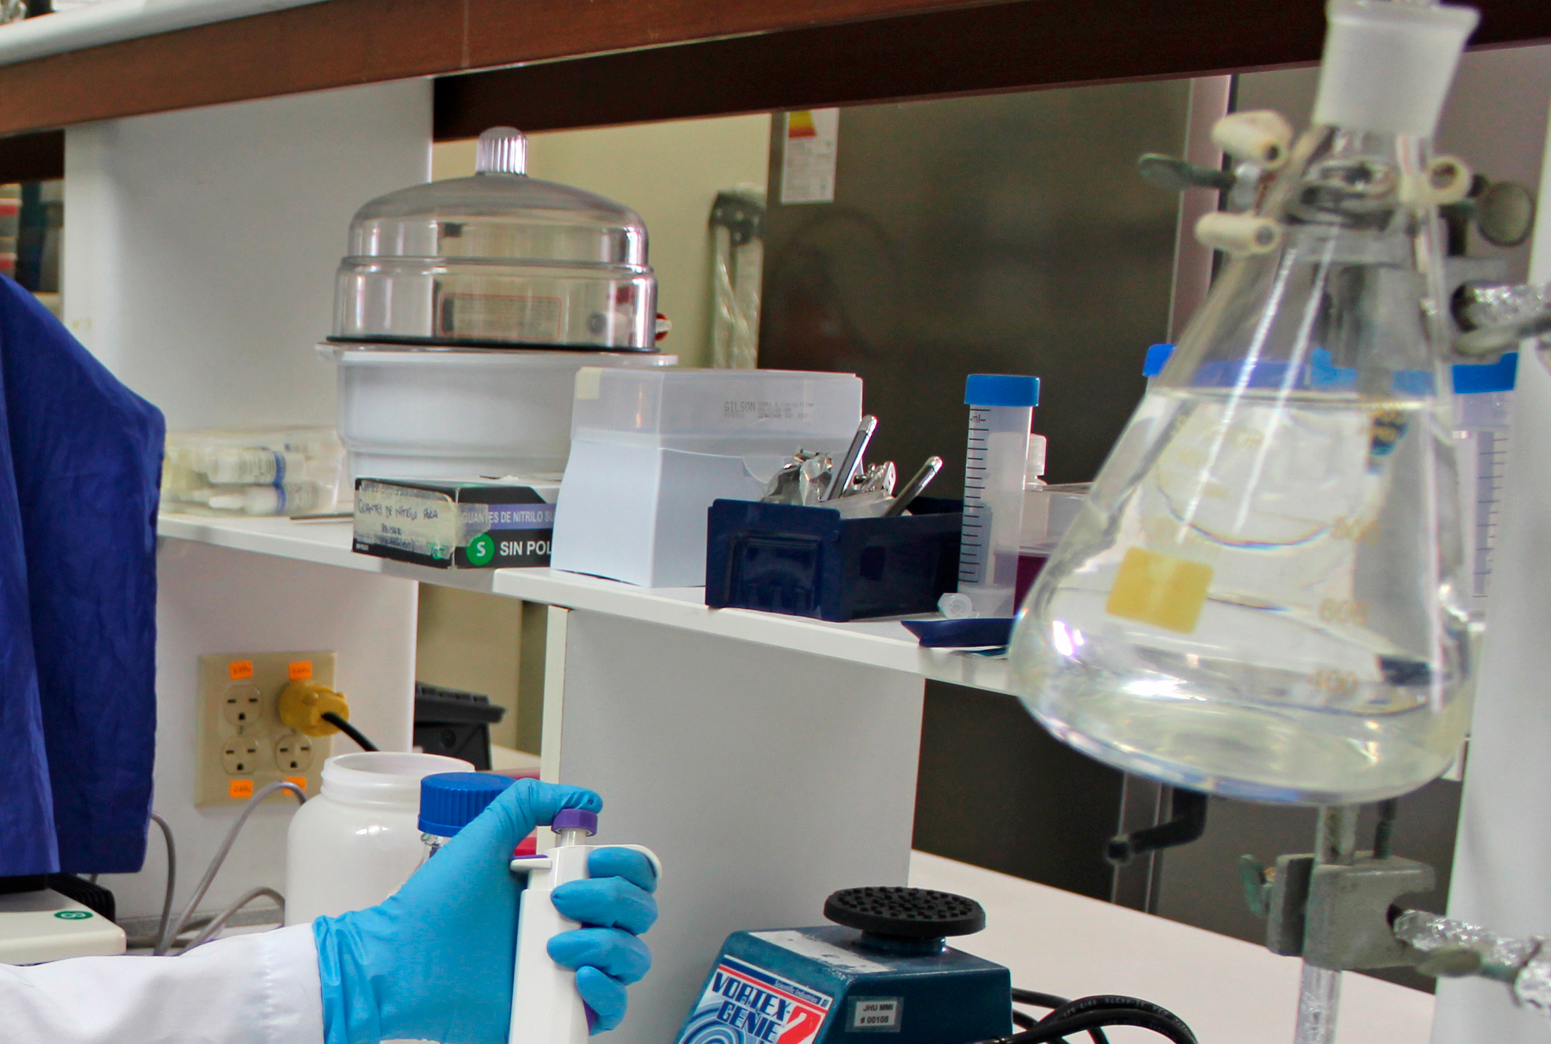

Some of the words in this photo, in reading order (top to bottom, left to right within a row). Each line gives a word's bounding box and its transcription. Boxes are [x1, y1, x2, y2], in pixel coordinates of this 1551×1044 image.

[724, 401, 756, 413] GILSON
[462, 511, 499, 524] GUANTES
[500, 511, 511, 523] DE
[513, 511, 544, 523] NITRILO
[476, 541, 486, 557] S
[499, 541, 523, 556] SIN
[863, 1004, 878, 1012] JHU
[716, 1000, 783, 1044] GENIE
